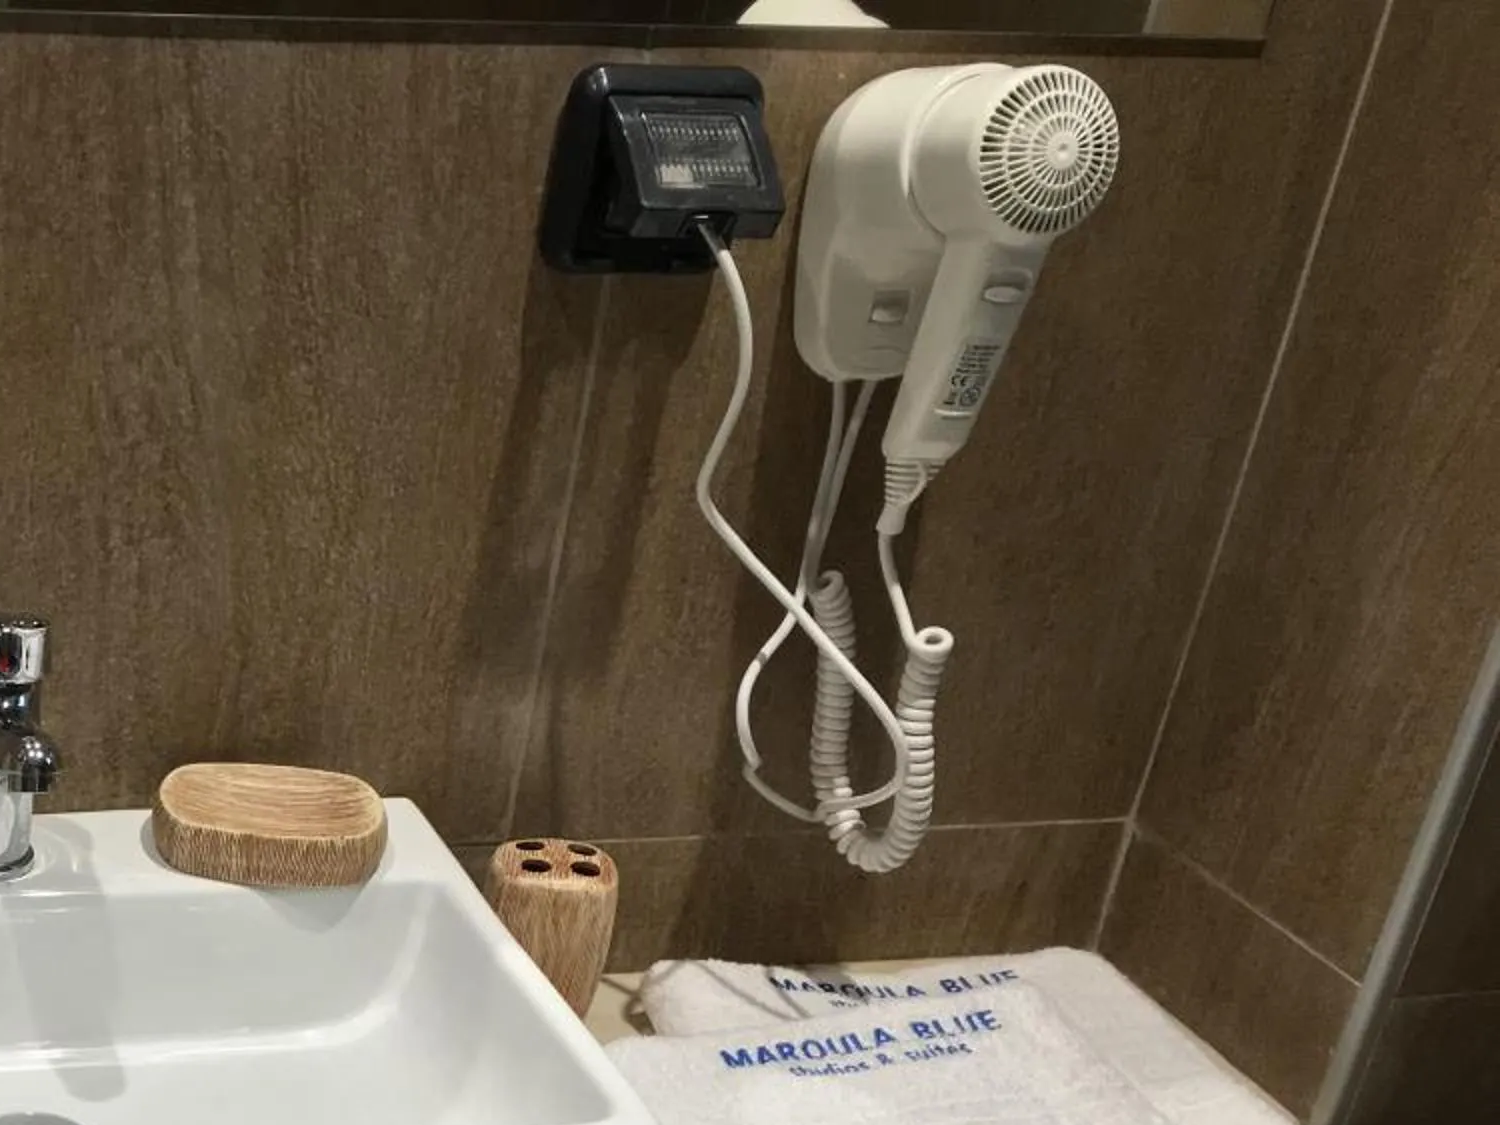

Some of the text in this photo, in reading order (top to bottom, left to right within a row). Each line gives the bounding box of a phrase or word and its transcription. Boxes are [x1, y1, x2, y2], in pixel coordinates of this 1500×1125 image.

[768, 969, 1020, 999] MAROULA BLUE
[718, 1008, 1003, 1069] MAROULA BLUE
